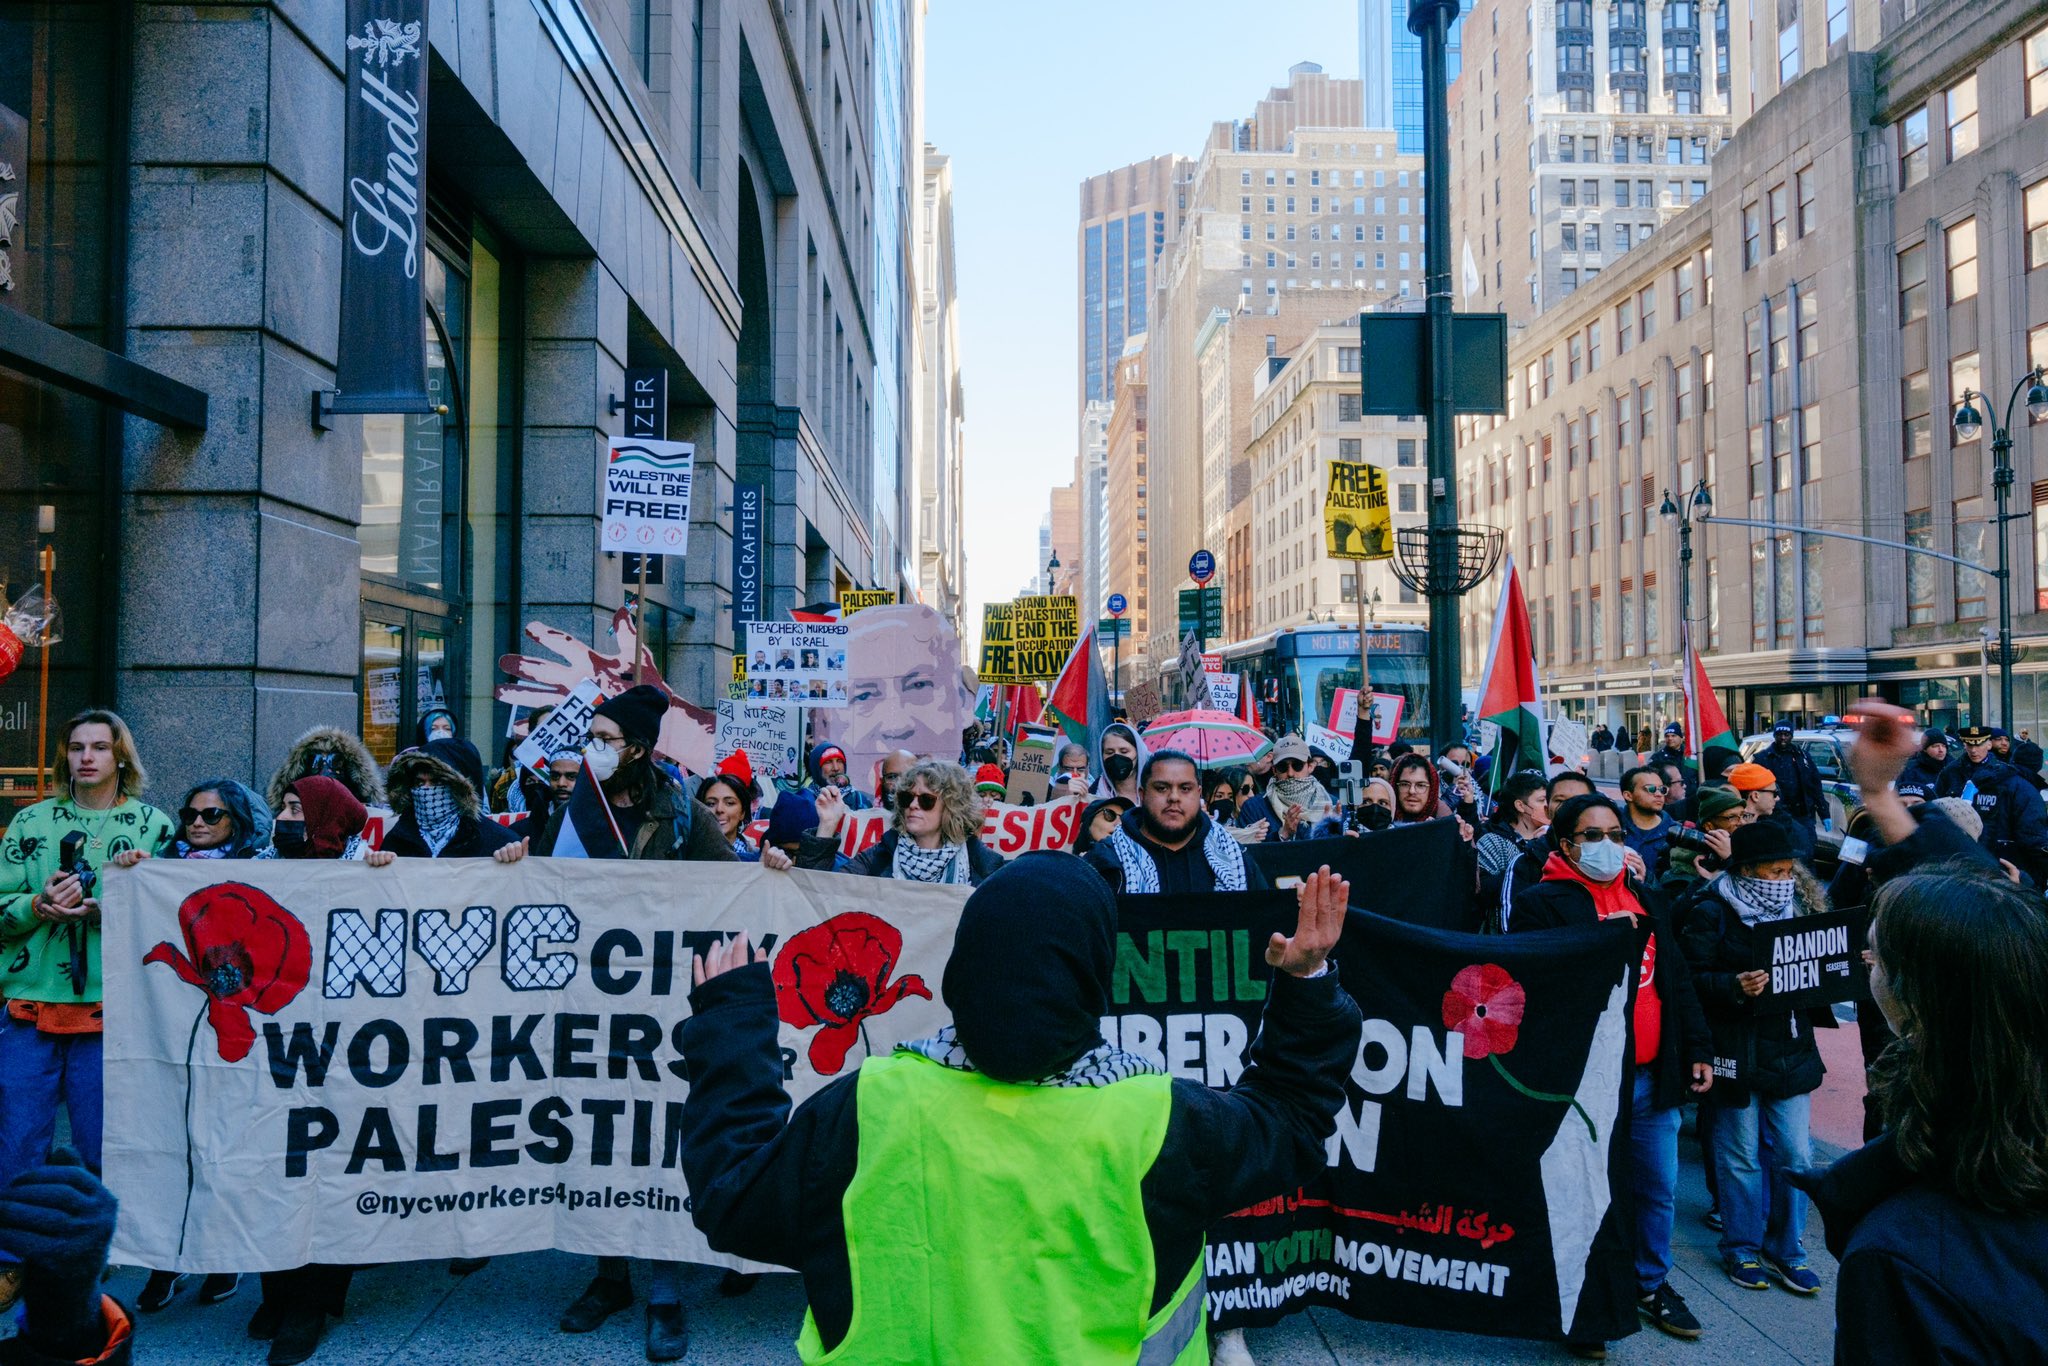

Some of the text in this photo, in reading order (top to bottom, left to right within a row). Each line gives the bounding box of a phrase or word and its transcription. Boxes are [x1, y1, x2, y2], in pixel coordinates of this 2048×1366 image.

[351, 68, 419, 279] Lindt
[608, 468, 691, 484] PALESTINE
[1331, 462, 1383, 494] FREE
[609, 480, 689, 497] WILL BE
[1325, 490, 1388, 510] PALESTINE
[606, 499, 688, 521] FREE!
[843, 592, 895, 607] PALESTINE
[1014, 596, 1076, 610] STAND WITH
[1015, 608, 1077, 622] PALESTINE!
[749, 623, 849, 636] TEACHERS MURDERED
[985, 621, 1014, 641] WILL
[1016, 621, 1078, 639] END THE
[768, 636, 830, 648] BY ISRAEL
[1016, 639, 1077, 652] OCCUPATION
[1312, 634, 1401, 650] NOT IN SRVICE
[1213, 684, 1231, 692] ALL
[1129, 692, 1159, 713] GAZA
[1223, 692, 1238, 700] AID
[725, 726, 787, 740] STOP THE
[731, 738, 785, 752] GENOCIDE
[1312, 735, 1327, 748] U.S.
[1329, 742, 1336, 751] &
[1021, 752, 1045, 763] SAVE
[757, 765, 777, 776] GAZA
[1010, 760, 1051, 775] PALESTINE
[1976, 794, 1997, 807] NYPD
[322, 904, 581, 999] NYC
[1772, 925, 1848, 965] ABANDON
[1825, 960, 1850, 972] CEASEFIRE
[1772, 959, 1820, 994] BIDEN
[1722, 1057, 1737, 1069] LIVE
[1333, 1234, 1510, 1297] MOVEMENT
